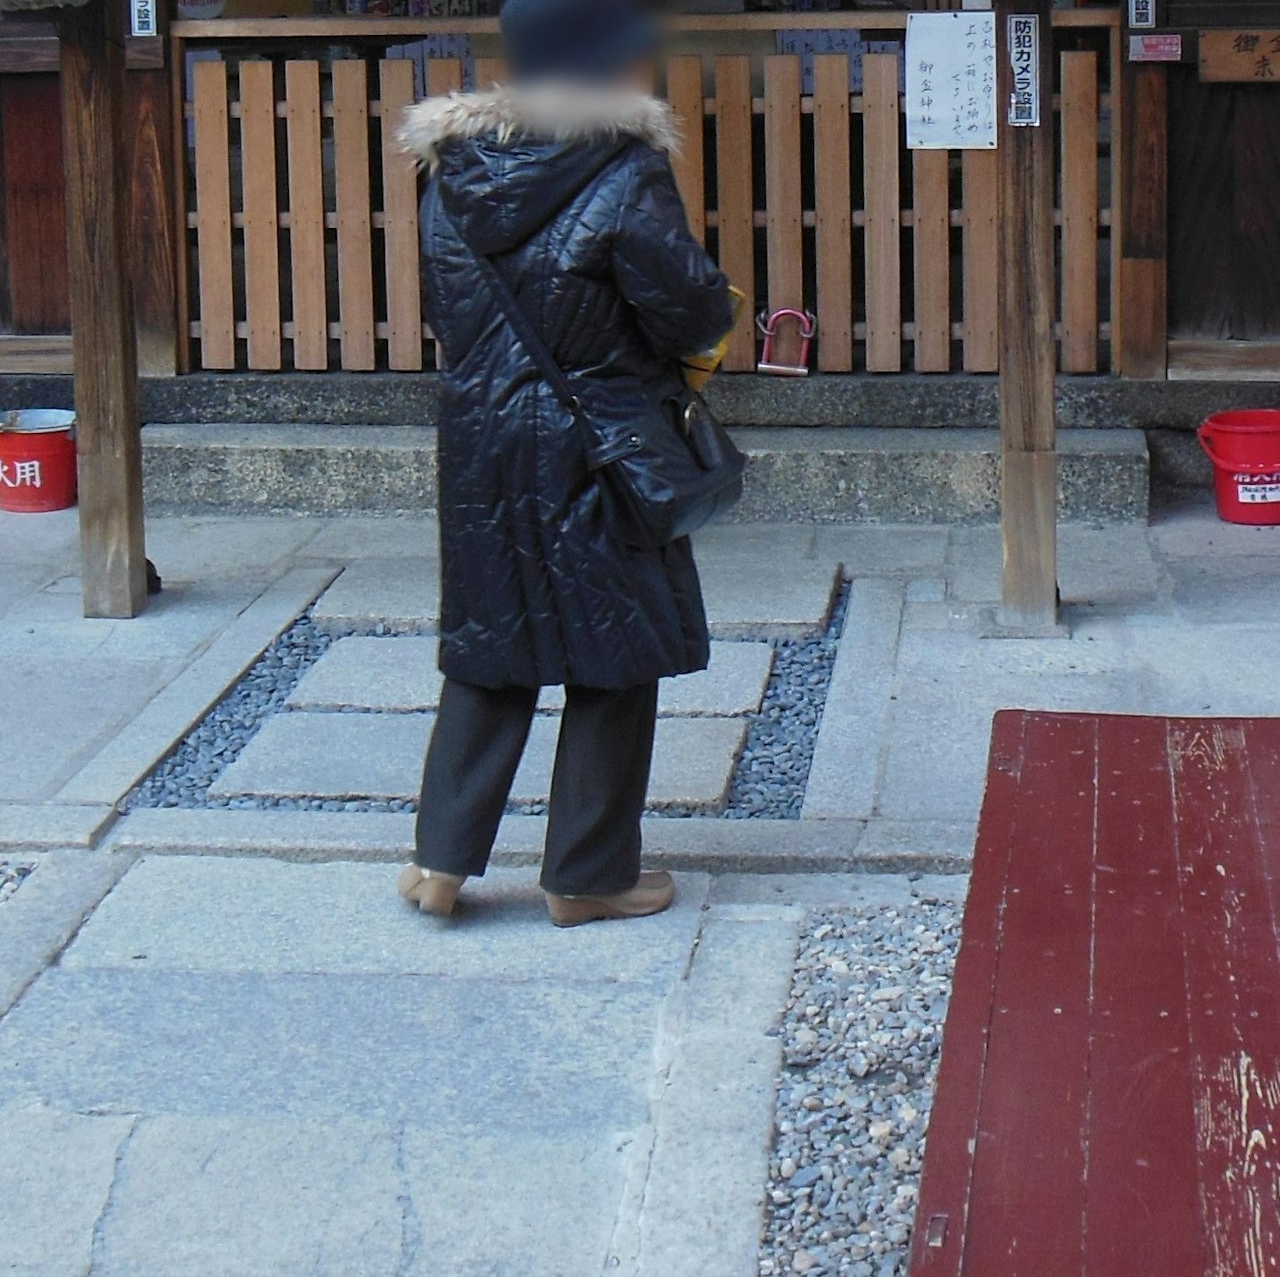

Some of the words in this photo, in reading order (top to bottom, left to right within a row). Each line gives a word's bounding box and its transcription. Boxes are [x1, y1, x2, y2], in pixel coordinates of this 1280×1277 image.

[918, 59, 936, 126] 御金神社
[1014, 20, 1033, 121] 防犯カメラ設置
